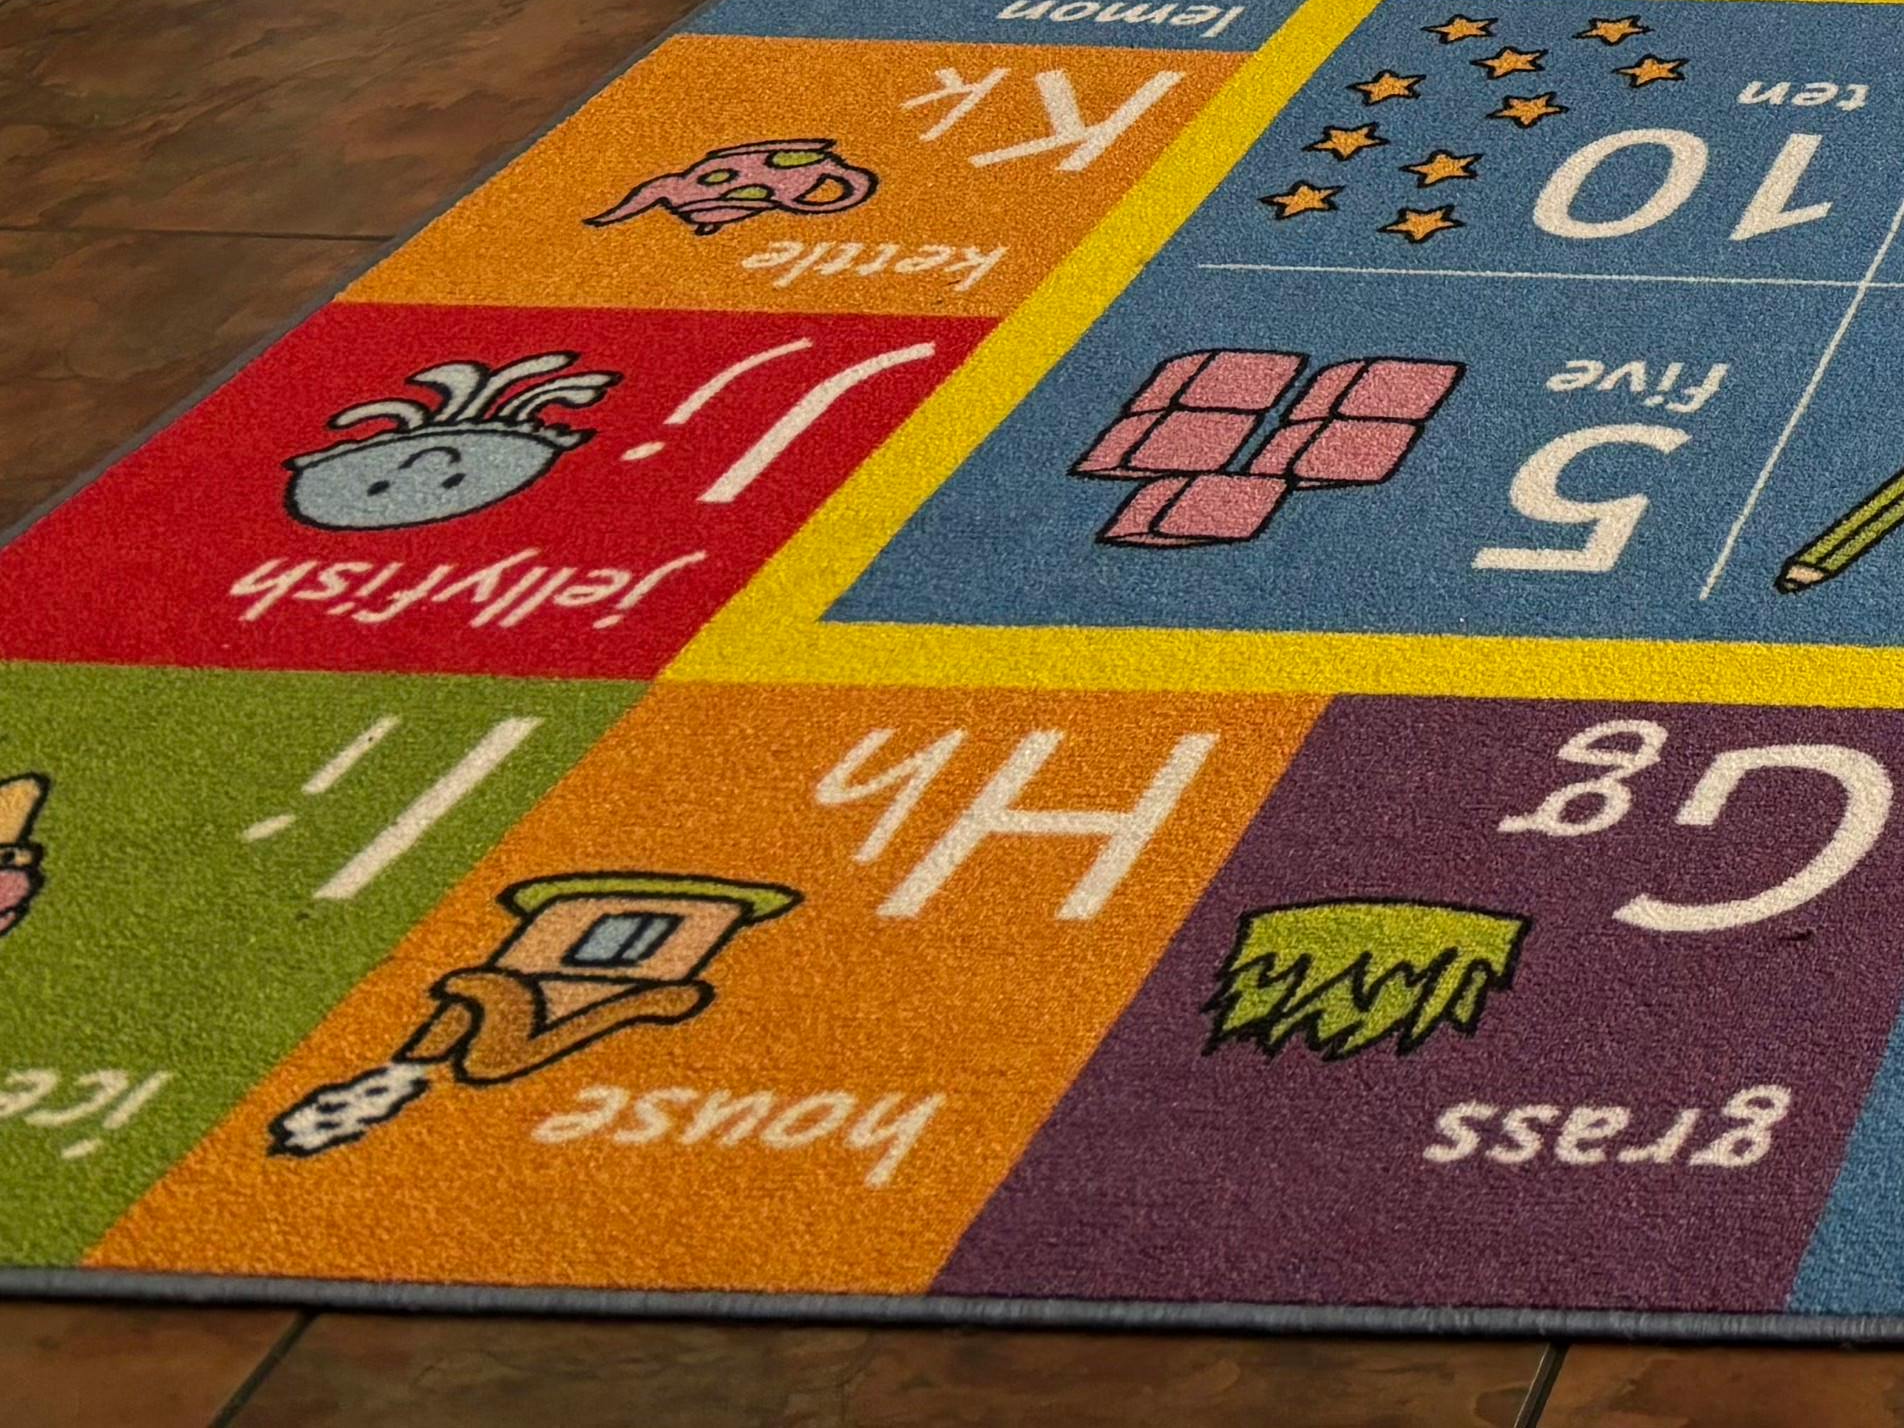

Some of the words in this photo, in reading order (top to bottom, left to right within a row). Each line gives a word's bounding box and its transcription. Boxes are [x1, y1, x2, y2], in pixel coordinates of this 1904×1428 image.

[997, 0, 1244, 37] lemon
[1738, 81, 1868, 111] ten
[1533, 128, 1832, 241] 10
[741, 240, 1006, 291] kettle
[1546, 359, 1729, 413] five
[1472, 423, 1691, 573] 5
[230, 549, 706, 629] jellyfish
[0, 1069, 173, 1160] ice
[532, 1085, 944, 1188] house
[1423, 1085, 1791, 1168] grass
